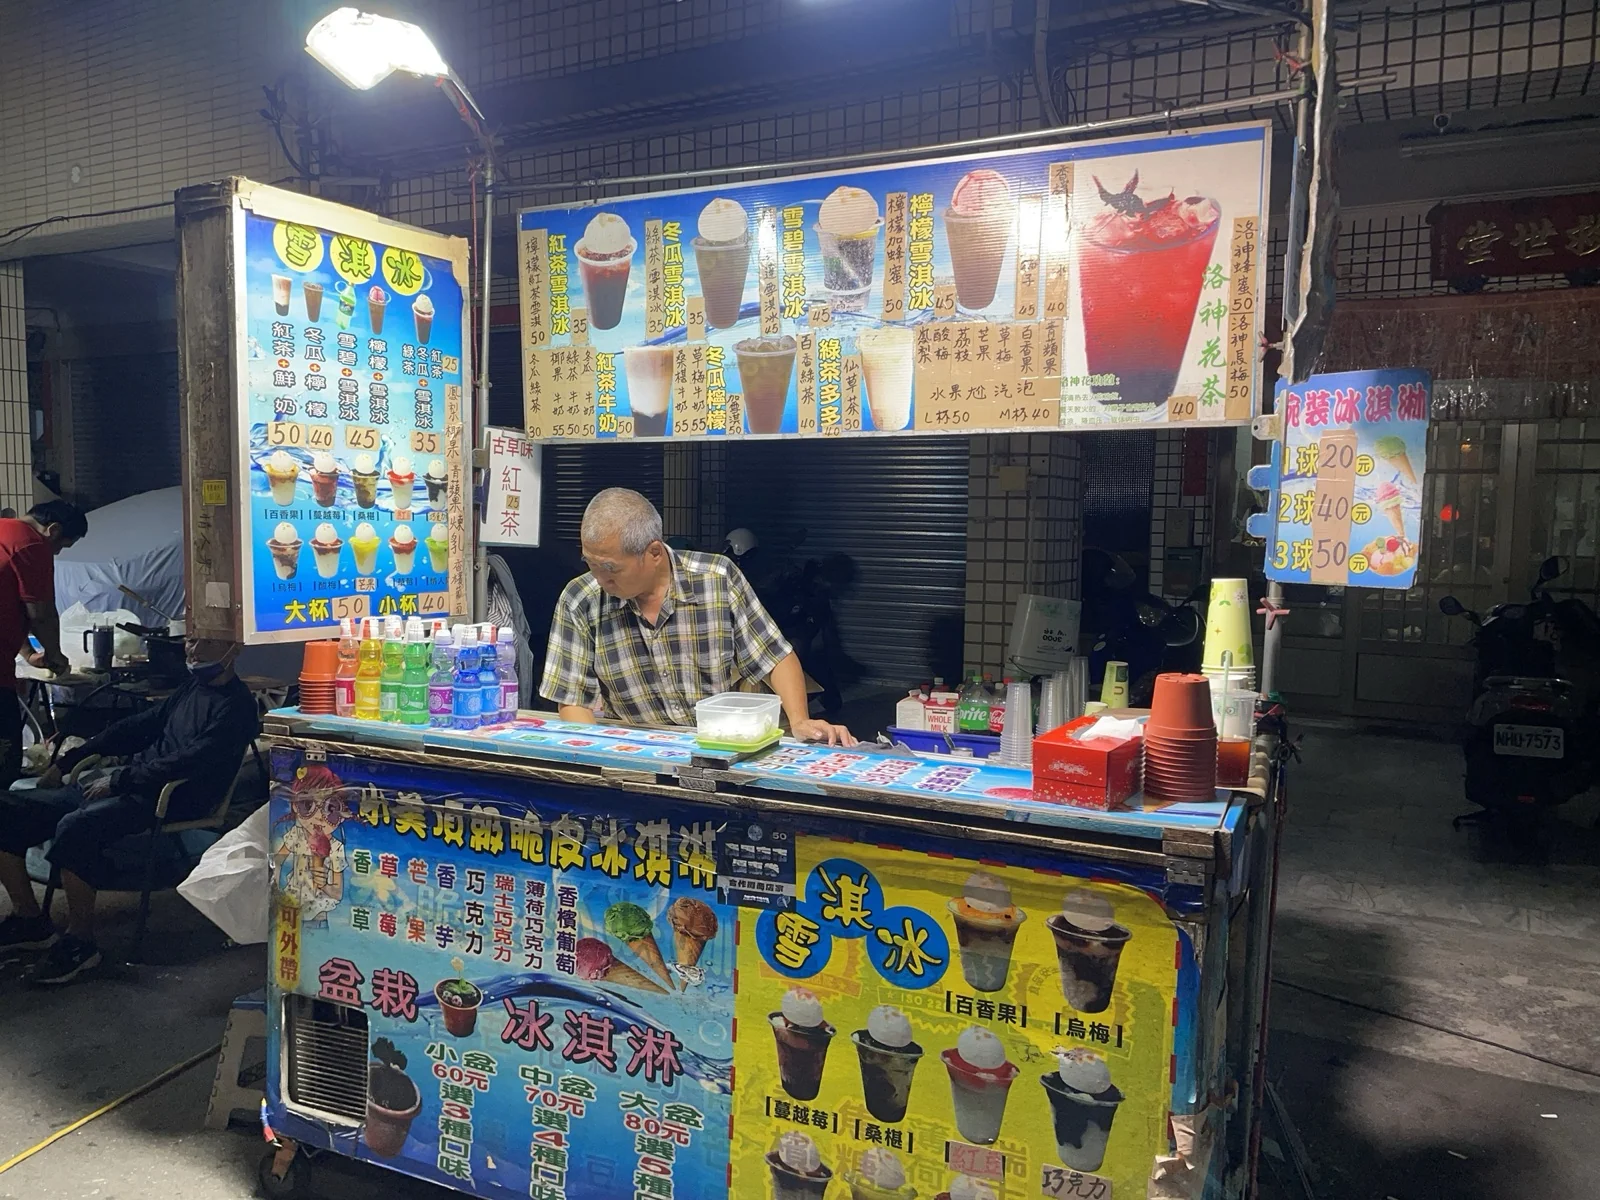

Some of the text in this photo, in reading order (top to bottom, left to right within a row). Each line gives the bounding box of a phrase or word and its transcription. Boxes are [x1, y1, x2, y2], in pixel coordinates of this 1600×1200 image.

[285, 221, 422, 288] 雪淇冰
[782, 206, 805, 319] 雪碧雪淇冰
[909, 193, 934, 311] 檸檬雪淇冰
[1231, 219, 1258, 311] 洛神蜂蜜 50
[548, 234, 571, 335] 紅茶雪淇冰
[663, 221, 685, 328] 冬瓜雪淇冰
[812, 308, 830, 323] 45
[885, 299, 903, 313] 50
[935, 293, 954, 310] 45
[1018, 306, 1035, 316] 45
[1046, 302, 1065, 312] 40
[573, 318, 587, 334] 35
[649, 319, 664, 333] 35
[689, 311, 704, 325] 35
[764, 323, 779, 334] 45
[531, 331, 545, 344] 50
[933, 327, 951, 360] 酸梅
[976, 327, 992, 361] 芒果
[1019, 326, 1034, 374] 百香果
[1042, 321, 1057, 375] 青蘋果
[1198, 263, 1230, 408] 洛神花茶
[402, 343, 416, 376] 綠茶
[430, 349, 444, 379] 紅茶
[444, 357, 458, 372] 25
[596, 353, 618, 433] 紅茶牛奶
[705, 346, 727, 430] 冬瓜檸檬
[818, 338, 842, 428] 綠茶多多
[843, 358, 860, 431] 仙草茶 30
[1229, 385, 1249, 398] 50
[1172, 402, 1194, 416] 40
[271, 422, 301, 445] 50
[310, 429, 333, 447] 40
[529, 426, 541, 438] 30
[552, 424, 565, 436] 55
[566, 423, 580, 435] 50
[582, 424, 595, 436] 50
[618, 421, 633, 434] 50
[674, 419, 689, 433] 55
[691, 418, 706, 431] 55
[729, 425, 742, 435] 50
[800, 419, 815, 429] 40
[824, 426, 841, 437] 40
[349, 430, 376, 449] 45
[414, 431, 437, 453] 35
[492, 437, 534, 459] 古早味
[500, 465, 522, 537] 紅茶
[507, 495, 520, 509] 25
[927, 714, 952, 724] WHOLE
[930, 724, 948, 733] MILK
[960, 707, 987, 721] prite
[465, 869, 486, 954] 巧克力
[493, 874, 515, 963] 瑞士巧克力
[524, 880, 546, 969] 薄荷巧克力
[774, 864, 943, 977] 雪淇冰
[556, 885, 578, 975] 香檳葡萄
[318, 956, 420, 1022] 盆栽
[501, 996, 684, 1086] 冰淇淋
[424, 1041, 499, 1075] 小盆
[431, 1062, 490, 1091] 60元
[518, 1063, 597, 1101] 中盆
[524, 1085, 585, 1118] 70元
[620, 1089, 704, 1131] 大盆
[437, 1081, 475, 1180] 選3種口味
[624, 1113, 692, 1147] 80元
[1042, 1169, 1107, 1200] 巧克力
